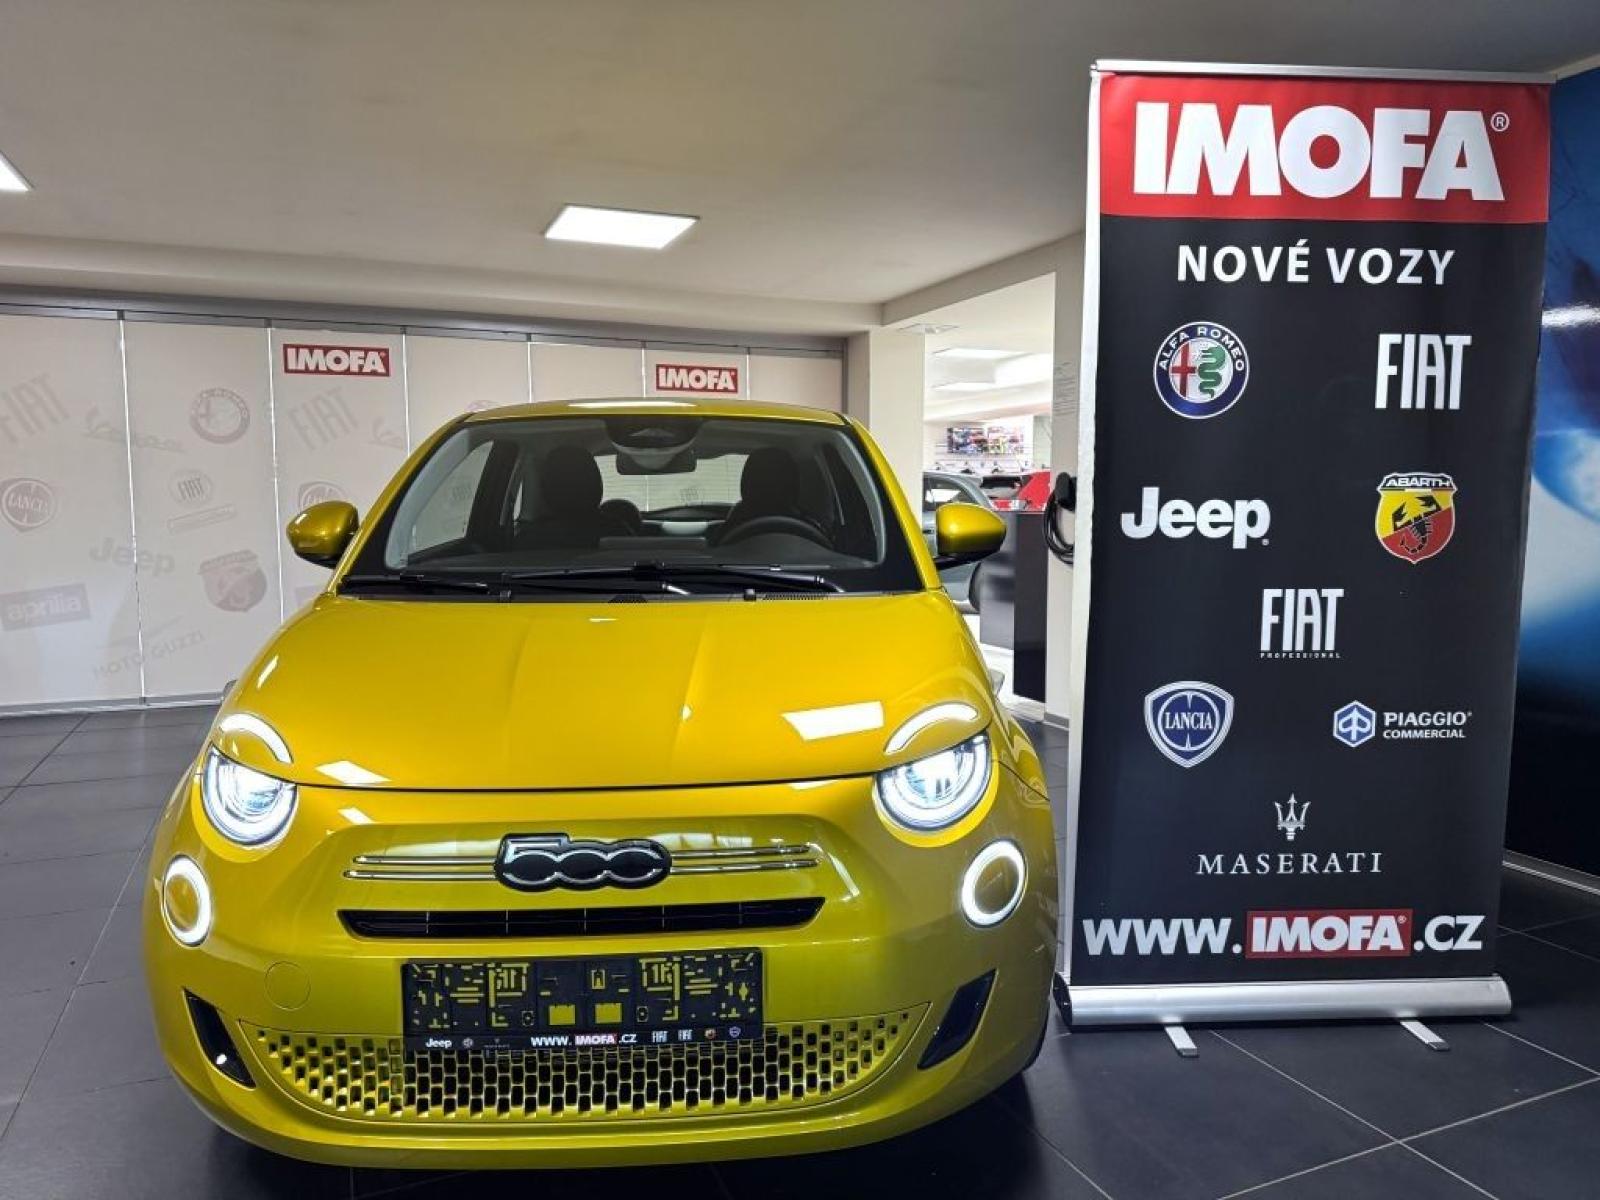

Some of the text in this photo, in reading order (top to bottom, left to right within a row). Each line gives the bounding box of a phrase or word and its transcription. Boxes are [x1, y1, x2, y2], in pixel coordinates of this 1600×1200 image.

[1133, 100, 1505, 201] IMOFA
[1177, 239, 1456, 285] NOVÉ VOZY
[286, 347, 387, 373] IMOFA
[1159, 326, 1245, 372] ALFA ROMEO
[658, 366, 736, 390] IMOFA
[1374, 333, 1473, 410] FIAT
[286, 386, 360, 451] FIAT
[1385, 477, 1450, 487] ABARTH
[1120, 487, 1271, 549] Jeep
[1260, 588, 1345, 651] FIAT
[1164, 710, 1214, 730] LANCIA
[1382, 710, 1468, 727] PIAGGIO
[1382, 729, 1467, 740] COMMERCIAL
[502, 836, 665, 886] 500
[1195, 852, 1383, 875] MASERATI
[425, 1037, 452, 1049] Jeep
